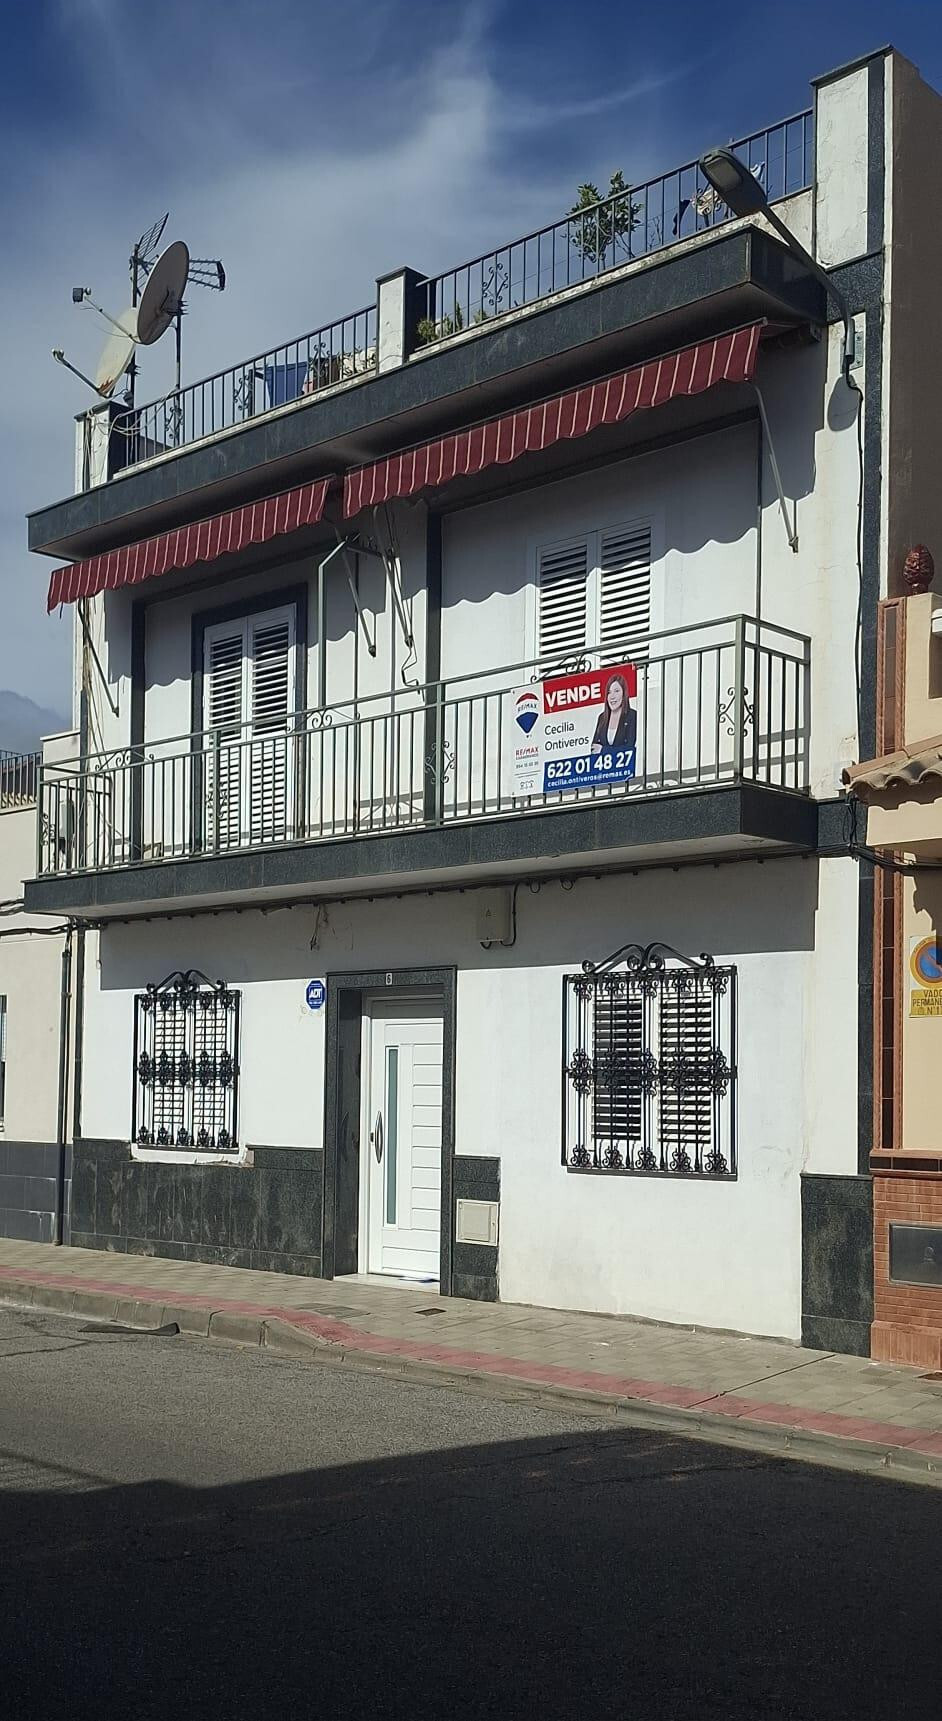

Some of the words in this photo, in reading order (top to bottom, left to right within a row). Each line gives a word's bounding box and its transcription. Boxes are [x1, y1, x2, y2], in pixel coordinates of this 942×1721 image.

[545, 682, 601, 708] VENDE
[517, 703, 537, 712] RE/MAX
[544, 721, 575, 736] Cecilia
[544, 736, 590, 751] Ontiveros
[515, 747, 539, 756] RE/MAX
[547, 761, 572, 779] 622
[575, 757, 591, 774] 01
[594, 754, 612, 771] 48
[616, 750, 634, 768] 27
[309, 988, 323, 999] ADT
